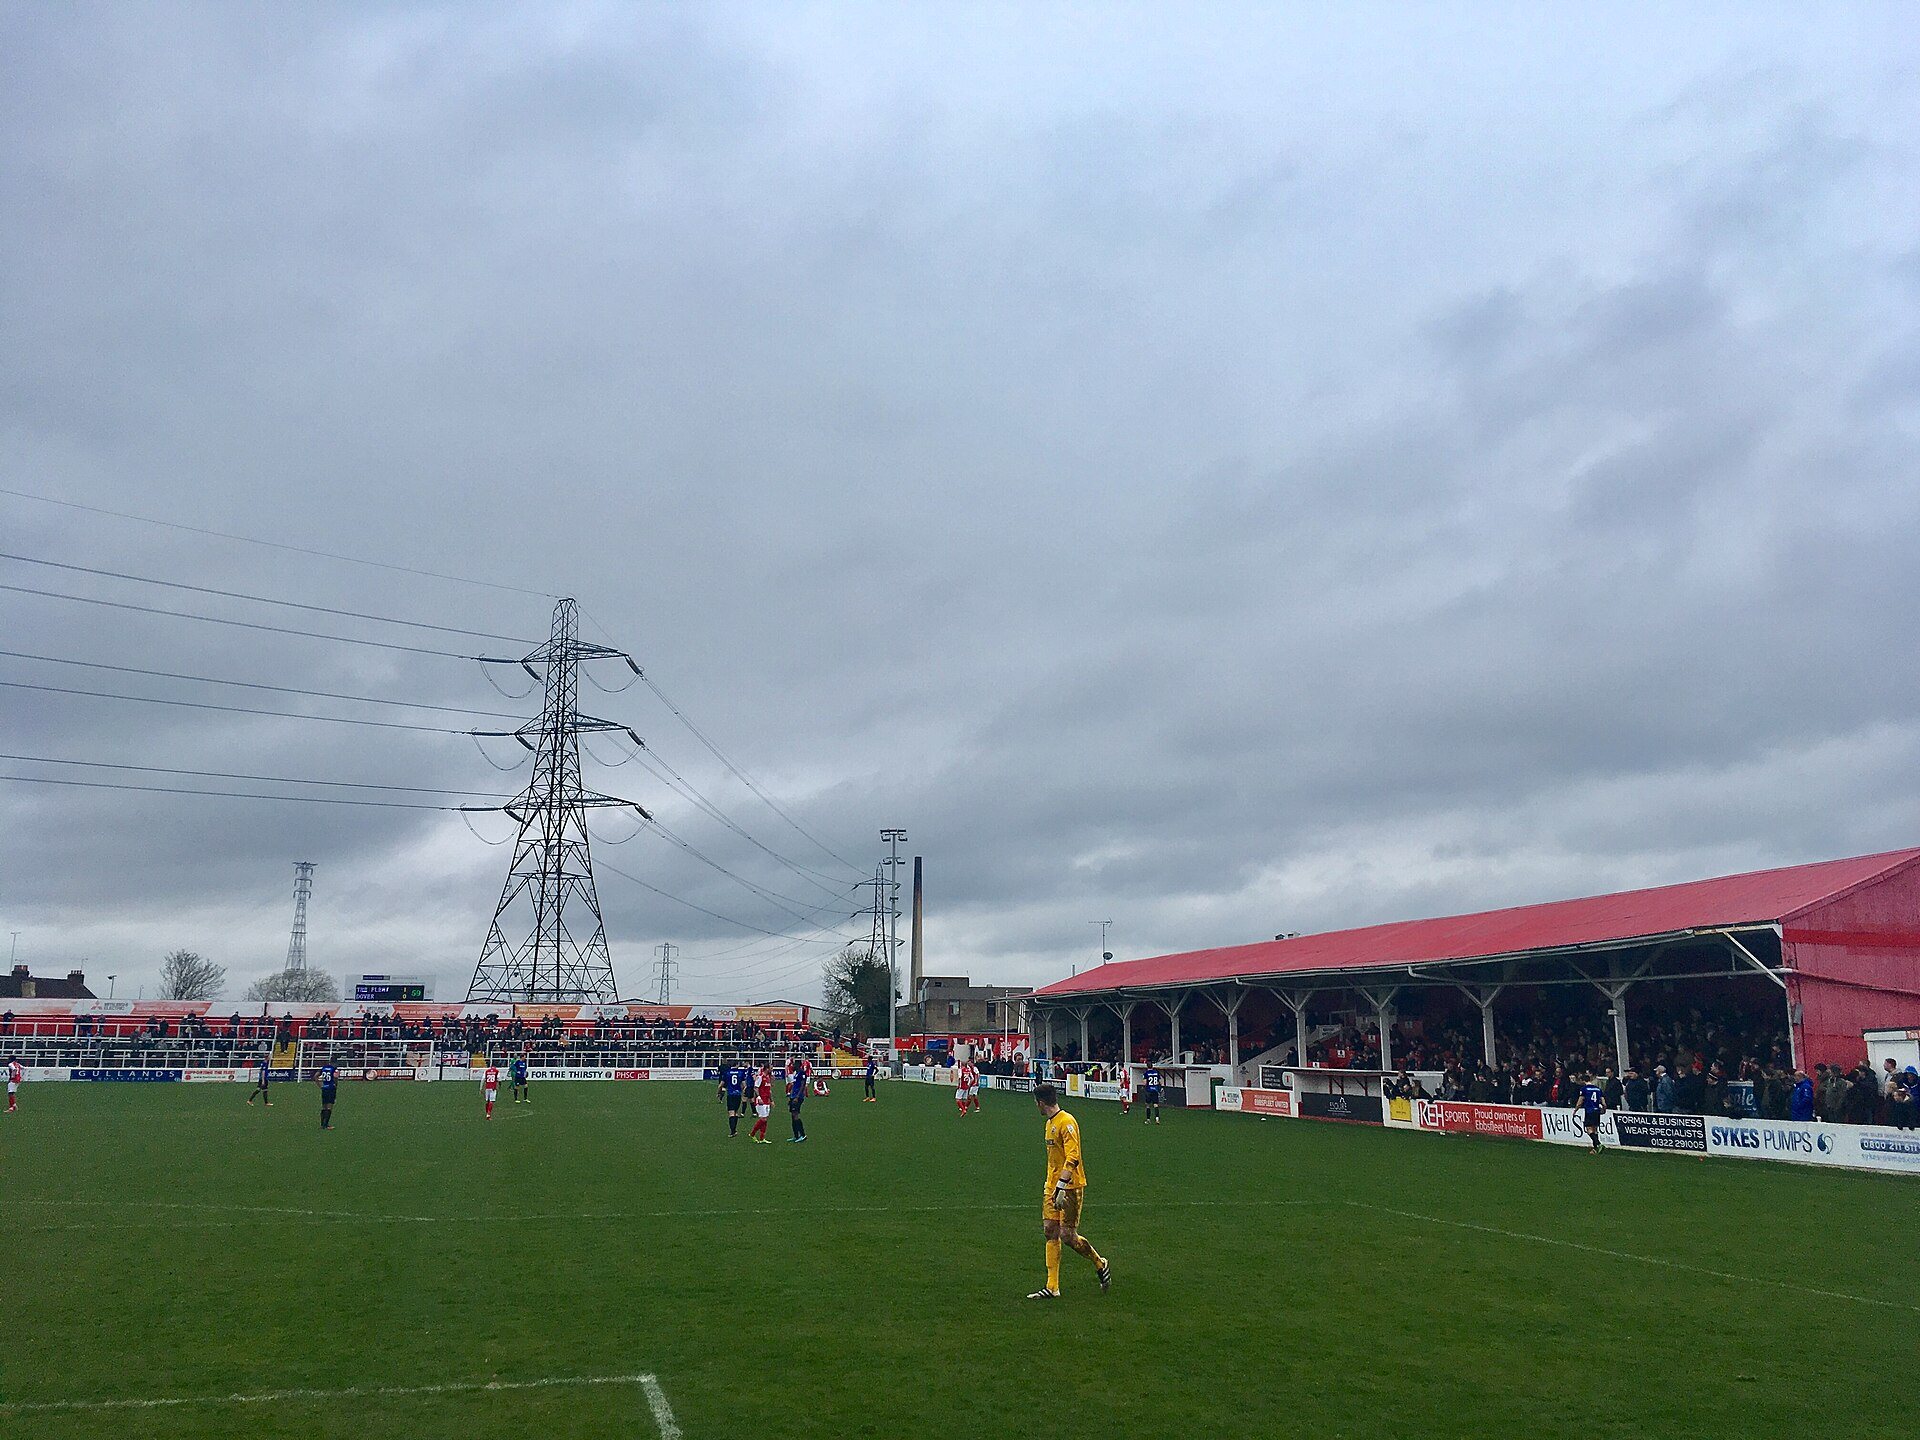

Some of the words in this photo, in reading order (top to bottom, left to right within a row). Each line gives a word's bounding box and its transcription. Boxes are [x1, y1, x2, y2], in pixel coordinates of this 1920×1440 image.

[411, 989, 421, 997] 59
[486, 1074, 496, 1083] 28
[568, 1071, 603, 1079] THIRSTY
[616, 1071, 635, 1079] PHSC
[637, 1071, 648, 1080] plc
[731, 1075, 738, 1085] 6
[1148, 1077, 1158, 1086] 28
[1591, 1091, 1598, 1103] 4
[1418, 1101, 1445, 1127] KEH
[1444, 1110, 1470, 1124] SPORTS
[1474, 1108, 1493, 1120] Proud
[1495, 1111, 1518, 1122] owners
[1519, 1111, 1526, 1123] of
[1543, 1112, 1571, 1135] Well
[1572, 1114, 1614, 1138] Sed
[1617, 1115, 1651, 1125] FORMAL
[1651, 1117, 1658, 1125] &
[1659, 1117, 1703, 1128] BUSINESS
[1475, 1120, 1504, 1133] Ebbsfleet
[1505, 1122, 1527, 1135] United
[1528, 1124, 1538, 1136] FC
[1624, 1126, 1649, 1135] WEAR
[1649, 1127, 1704, 1139] SPECIALISTS
[1651, 1138, 1674, 1147] 01322
[1675, 1140, 1705, 1149] 291005
[1711, 1126, 1760, 1149] SYKES
[1763, 1129, 1813, 1153] PUMPS
[1863, 1140, 1886, 1149] 0800
[1889, 1142, 1902, 1151] 211
